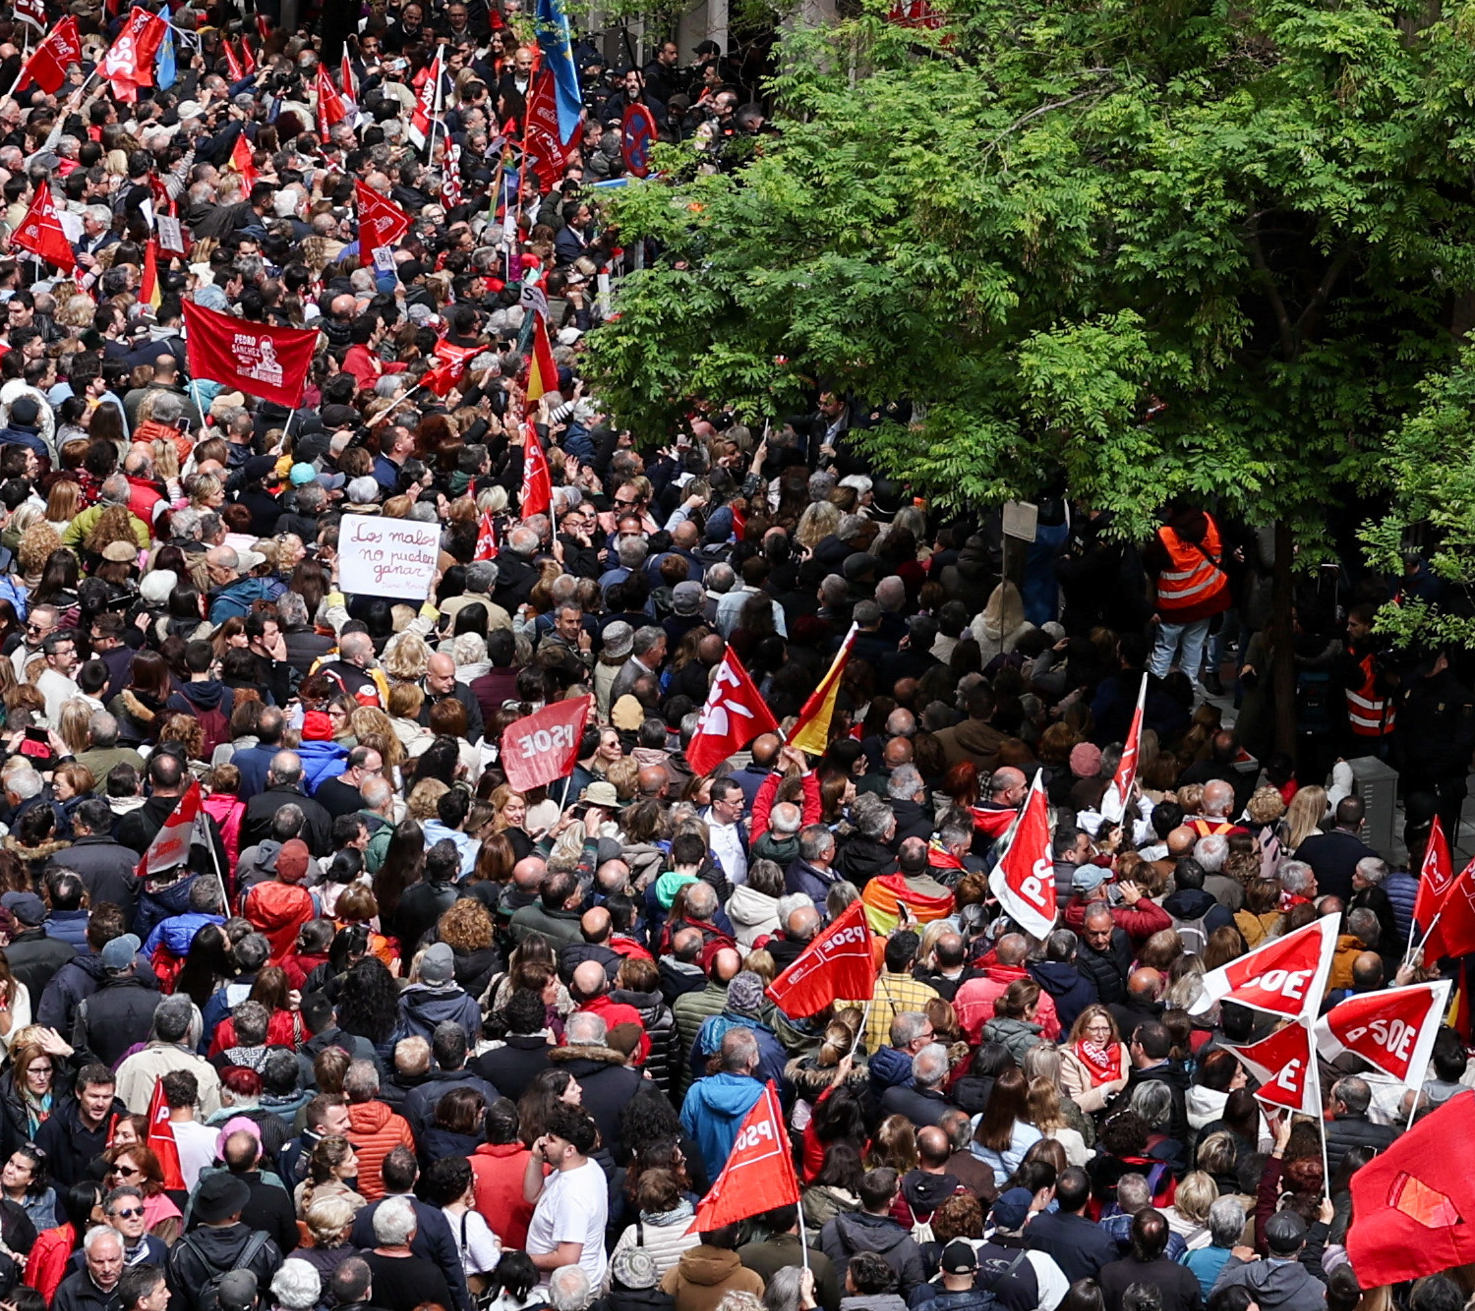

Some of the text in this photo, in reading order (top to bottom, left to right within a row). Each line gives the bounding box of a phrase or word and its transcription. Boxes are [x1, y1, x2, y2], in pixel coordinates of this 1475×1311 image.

[41, 205, 59, 221] PS
[233, 334, 257, 347] PEDRO
[231, 344, 262, 359] SÁNCHEZ
[389, 529, 436, 547] malos
[358, 548, 435, 566] no pueden
[1345, 1019, 1417, 1062] PSOE
